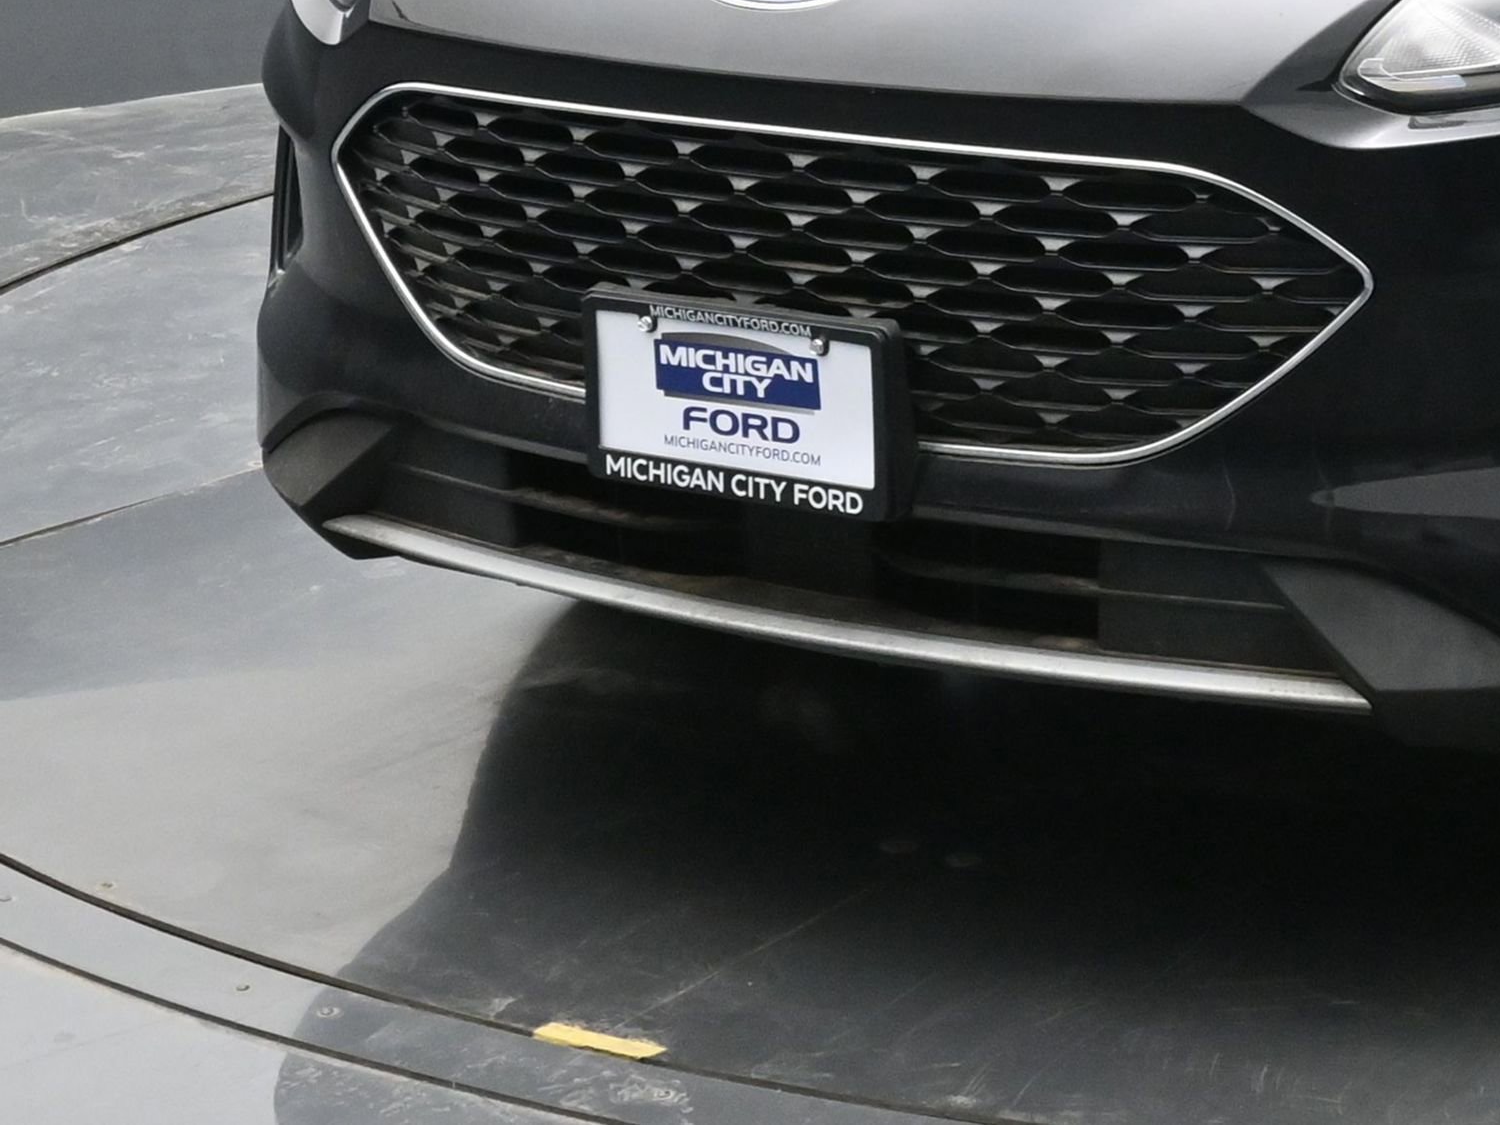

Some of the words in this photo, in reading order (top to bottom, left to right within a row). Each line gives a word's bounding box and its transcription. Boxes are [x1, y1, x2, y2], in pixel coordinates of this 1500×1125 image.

[650, 304, 812, 337] MICHIGANCITYFORD.COM
[659, 344, 814, 383] MICHIGAN
[702, 372, 772, 399] CITY
[682, 406, 801, 444] FORD
[664, 434, 821, 466] MICHIGANCITYFORD.COM
[605, 454, 725, 493] MICHIGAN
[731, 474, 787, 503] CITY
[793, 483, 864, 515] FORD
